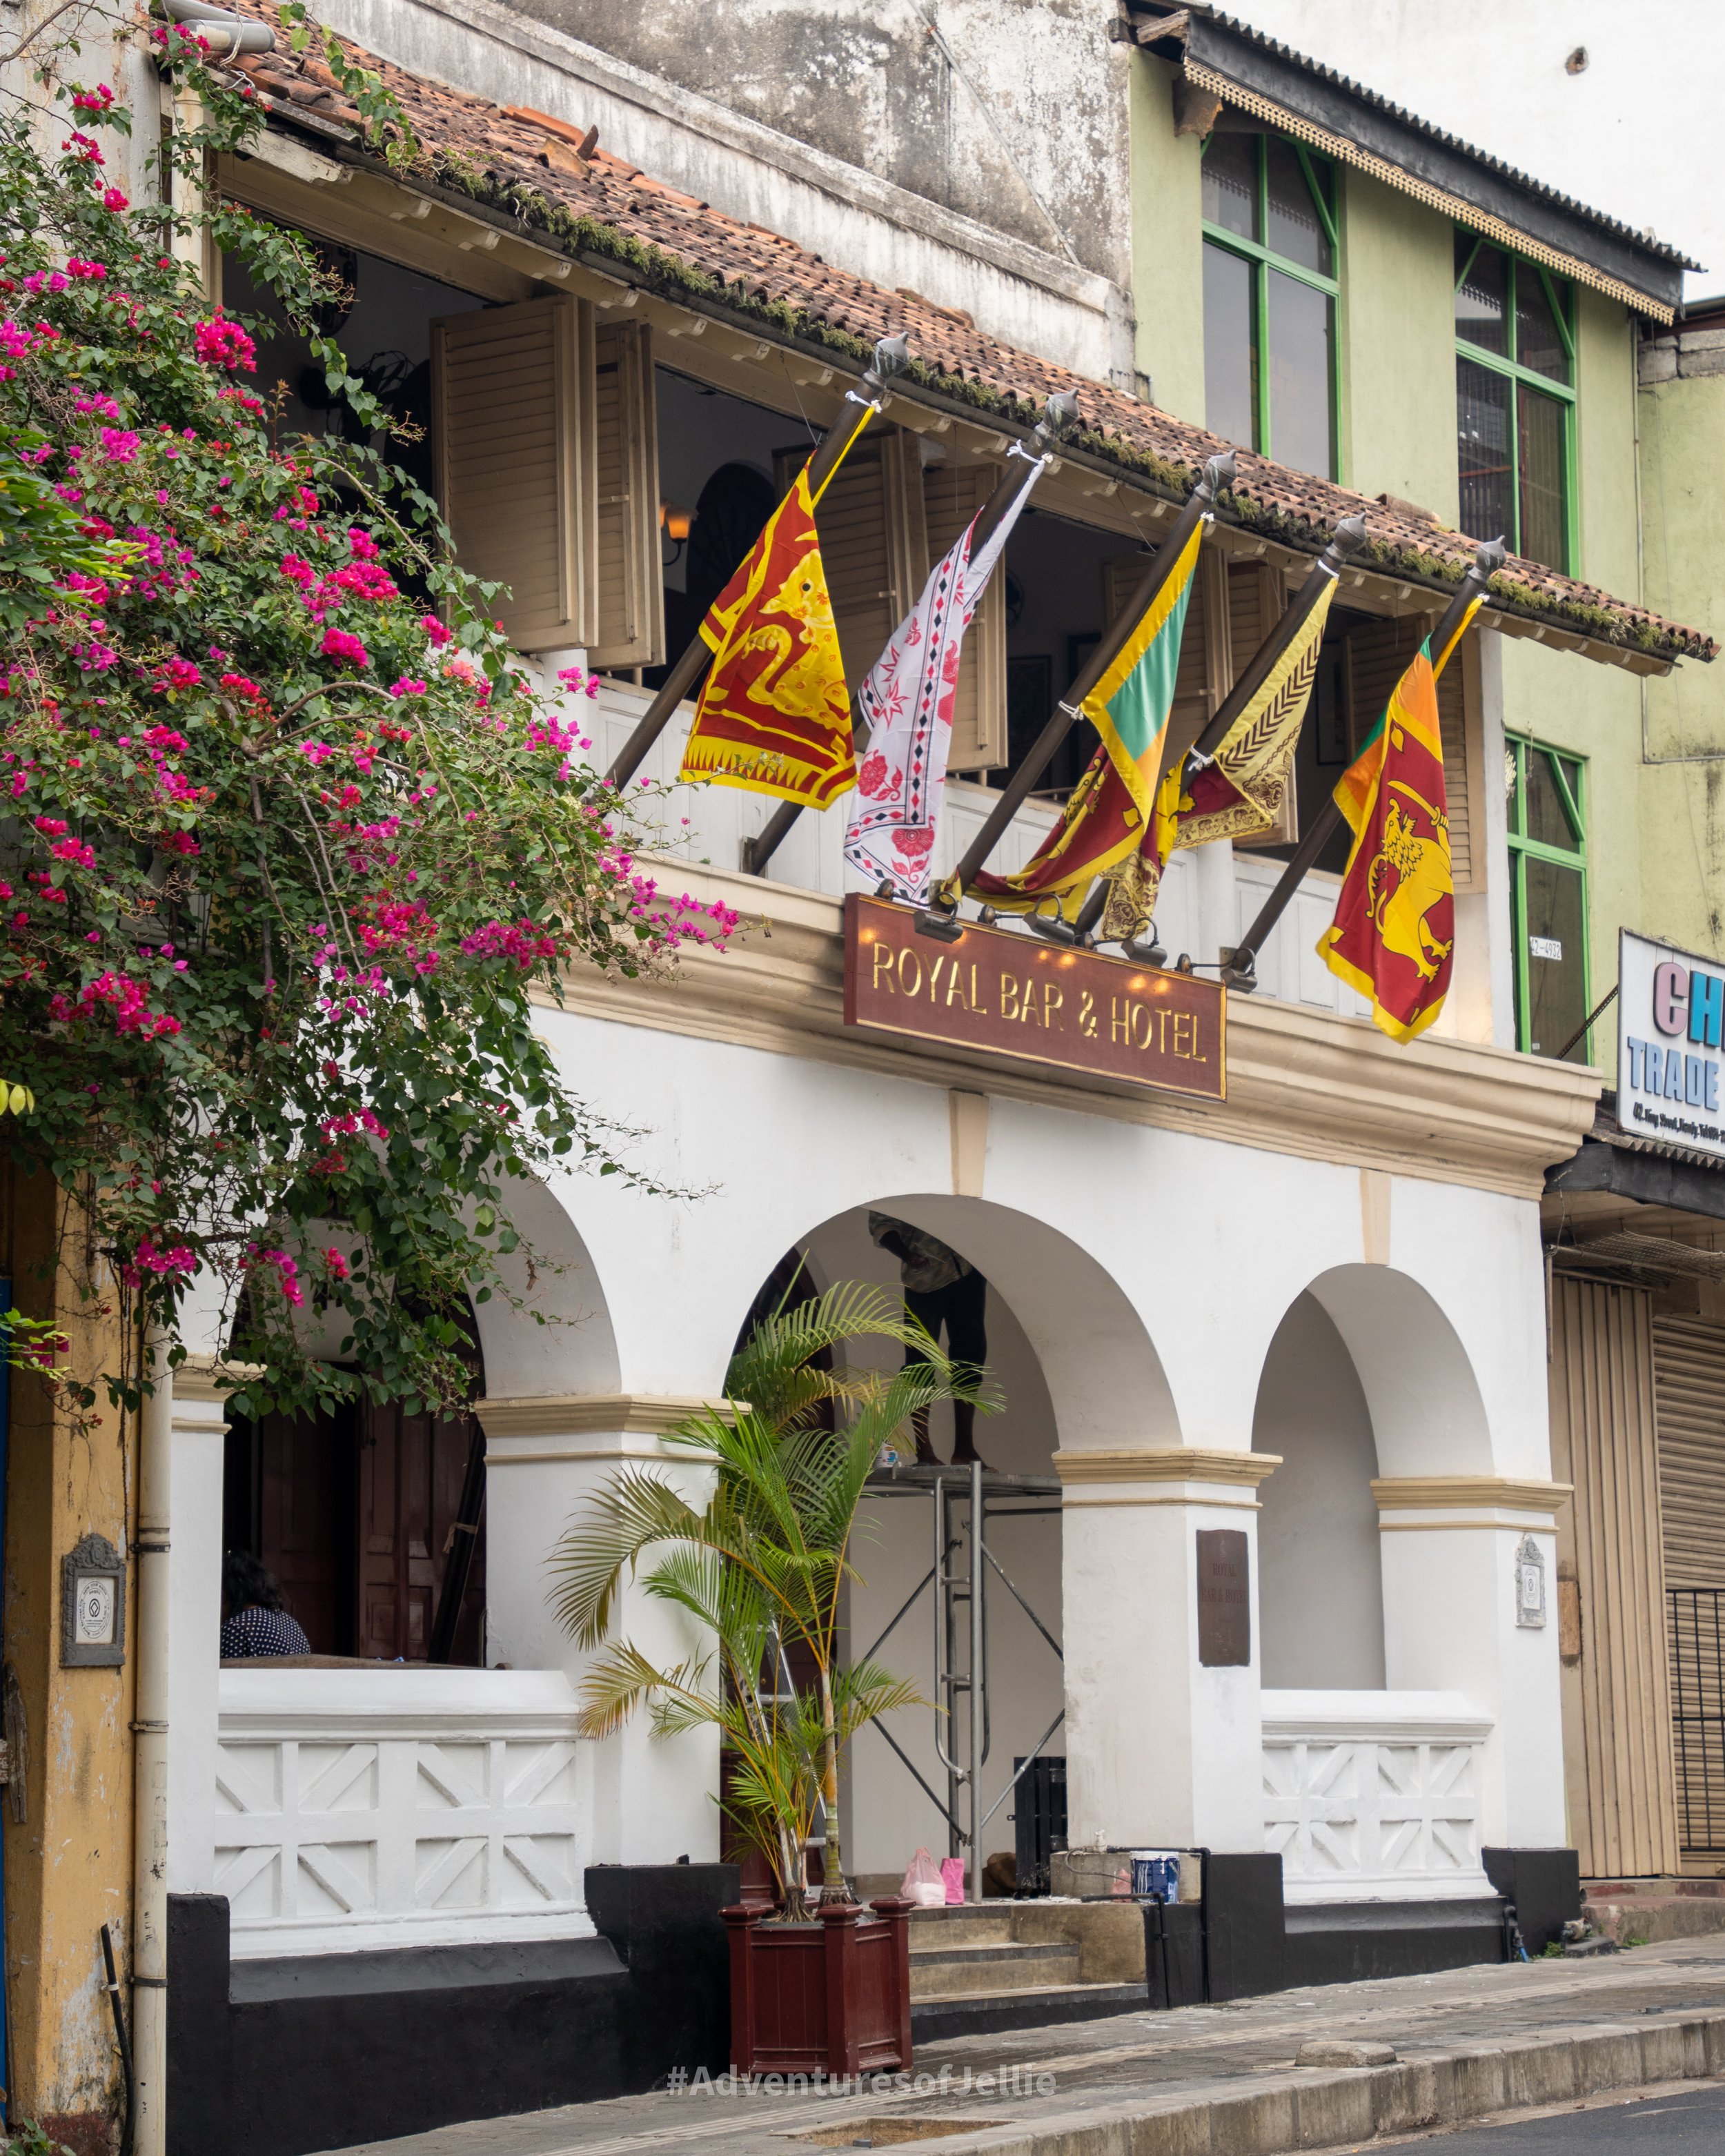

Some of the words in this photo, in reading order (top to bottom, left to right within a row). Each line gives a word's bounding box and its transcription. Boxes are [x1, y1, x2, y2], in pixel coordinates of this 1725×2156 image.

[874, 941, 987, 1015] ROYAL
[1001, 971, 1065, 1031] BAR
[1079, 987, 1098, 1038] &
[1112, 996, 1206, 1062] HOTEL
[1653, 962, 1725, 1051] CH
[1628, 1036, 1719, 1111] TRADE
[1201, 1588, 1217, 1602] BAR
[1218, 1588, 1224, 1603] &
[1225, 1589, 1248, 1604] HOTEL
[1212, 1563, 1237, 1577] ROYAL
